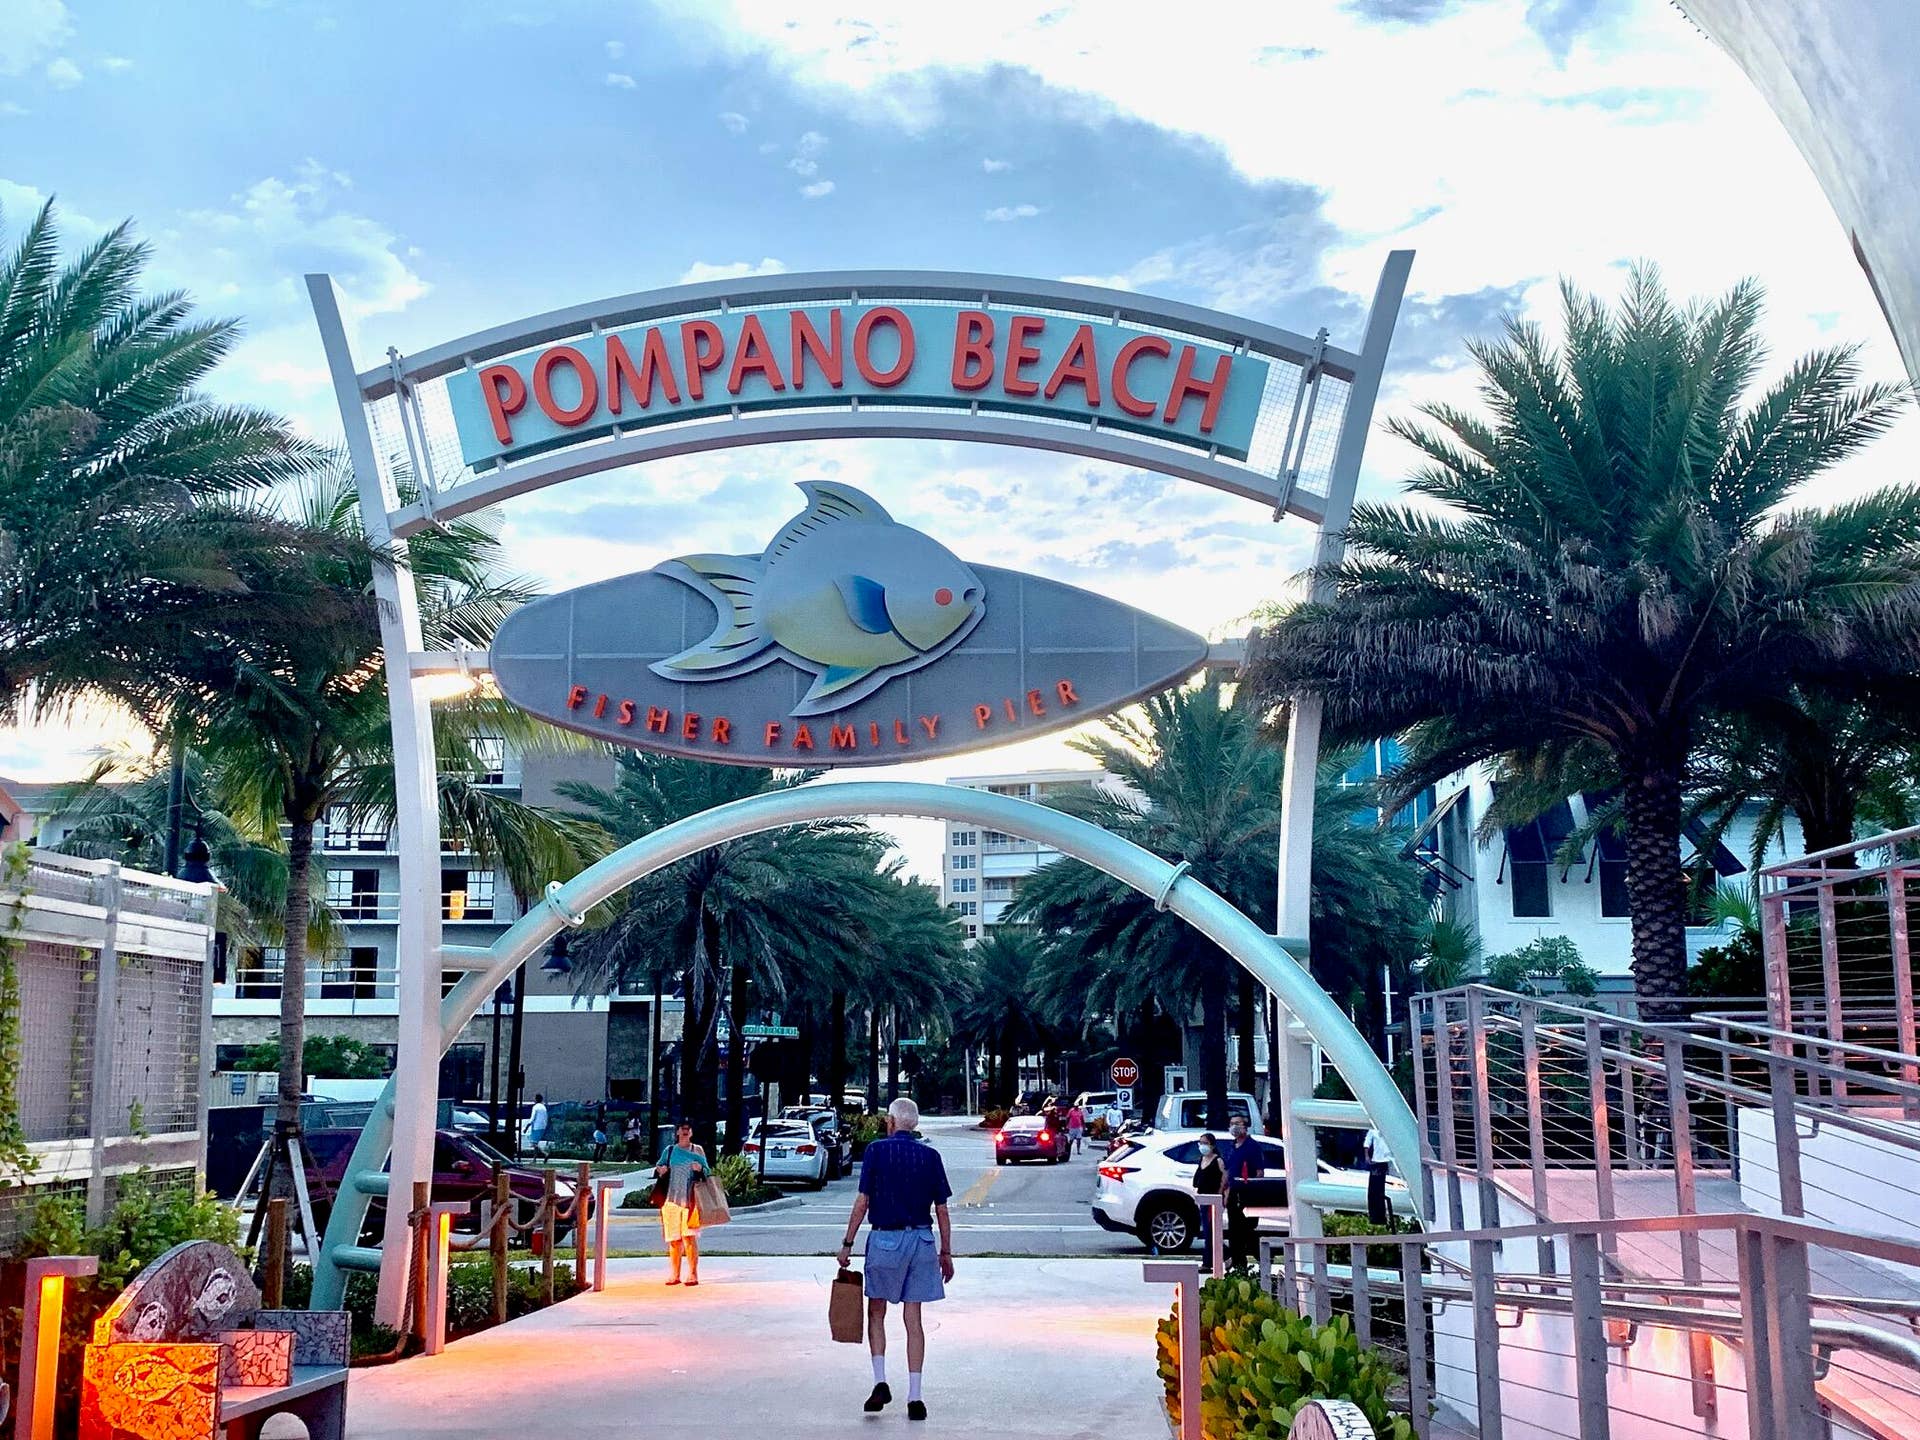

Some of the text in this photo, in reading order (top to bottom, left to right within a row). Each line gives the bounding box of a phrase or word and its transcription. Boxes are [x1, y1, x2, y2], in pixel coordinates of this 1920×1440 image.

[478, 305, 1233, 445] POMPANO BEACH
[567, 678, 1081, 749] FISHER FAMILY PIER
[1113, 1066, 1136, 1077] STOP
